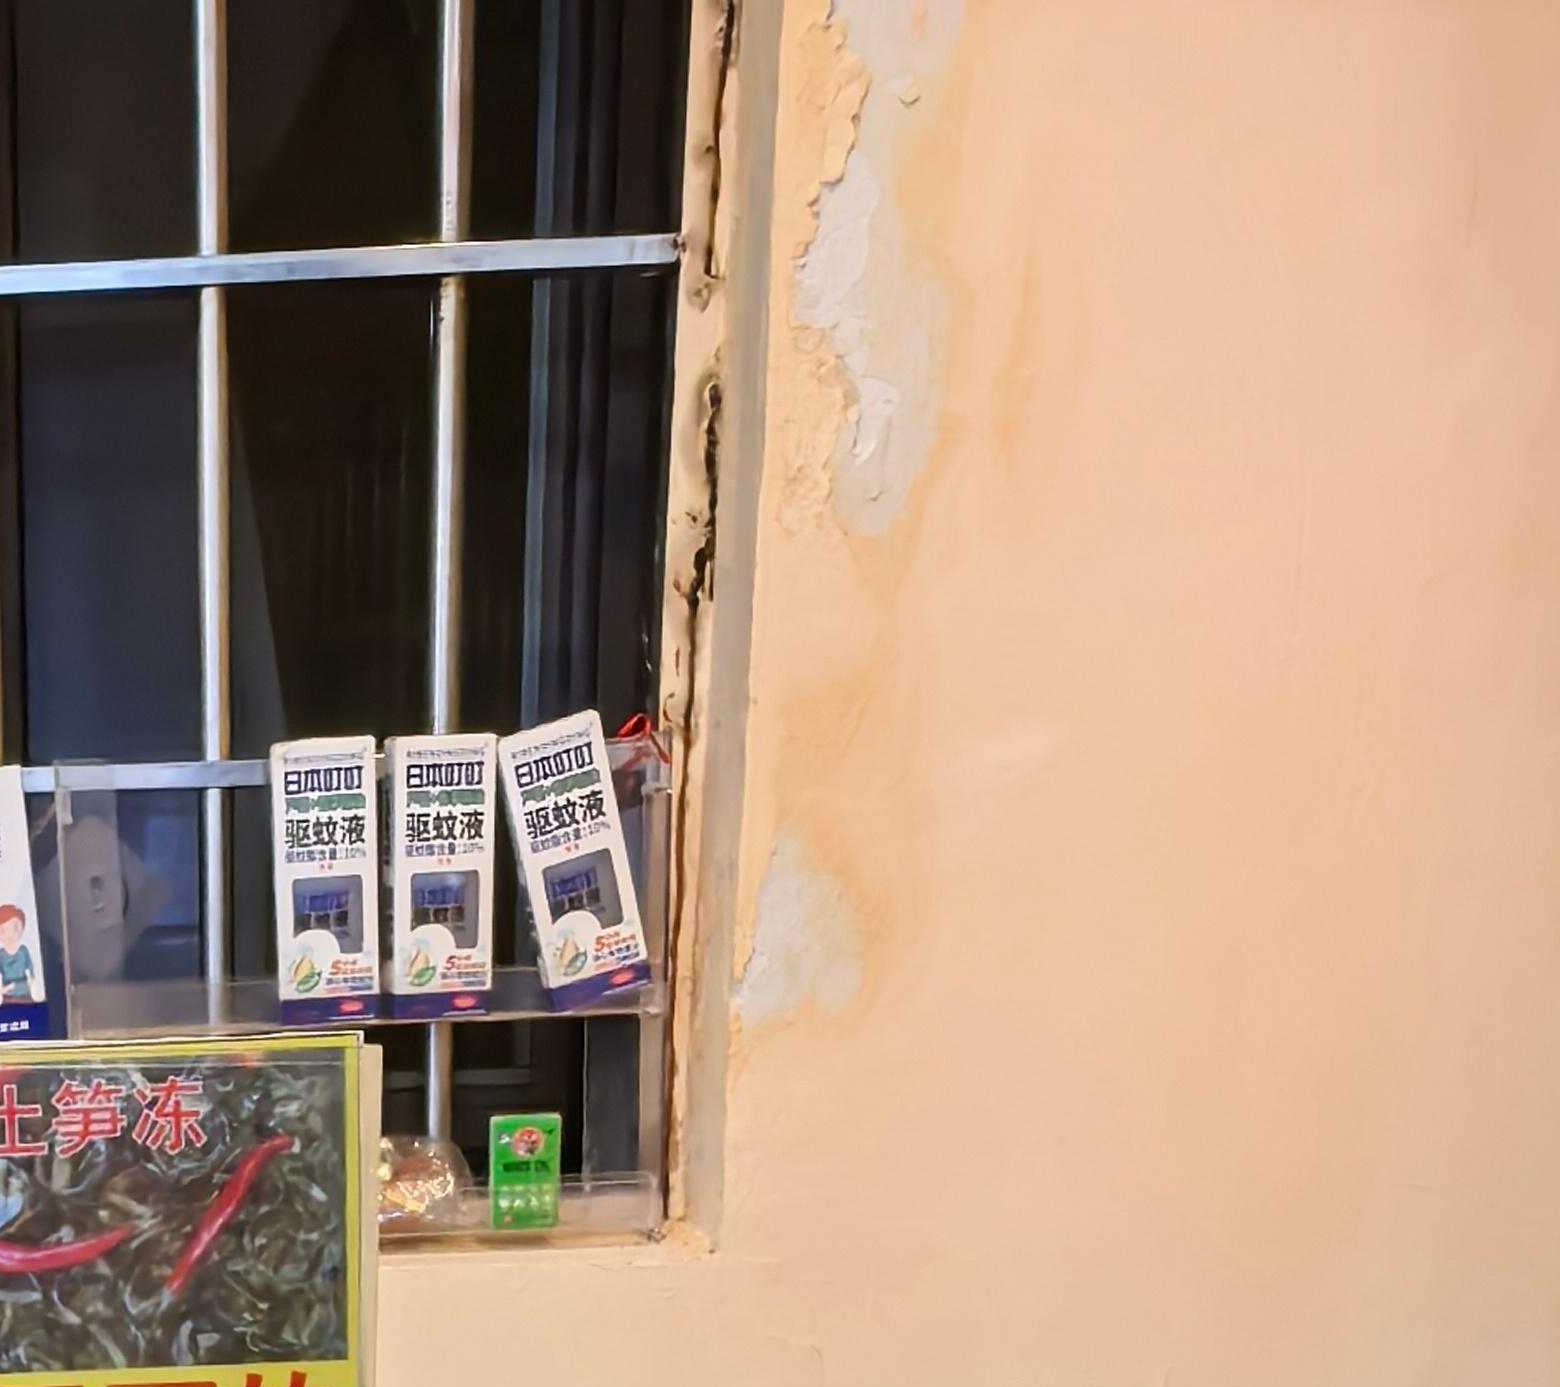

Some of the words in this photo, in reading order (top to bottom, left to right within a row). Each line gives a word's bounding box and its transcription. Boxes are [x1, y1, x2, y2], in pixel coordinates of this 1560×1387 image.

[284, 814, 366, 849] 驱蚊液
[405, 810, 485, 843] 驱蚊液
[523, 790, 607, 840] 驱蚊液
